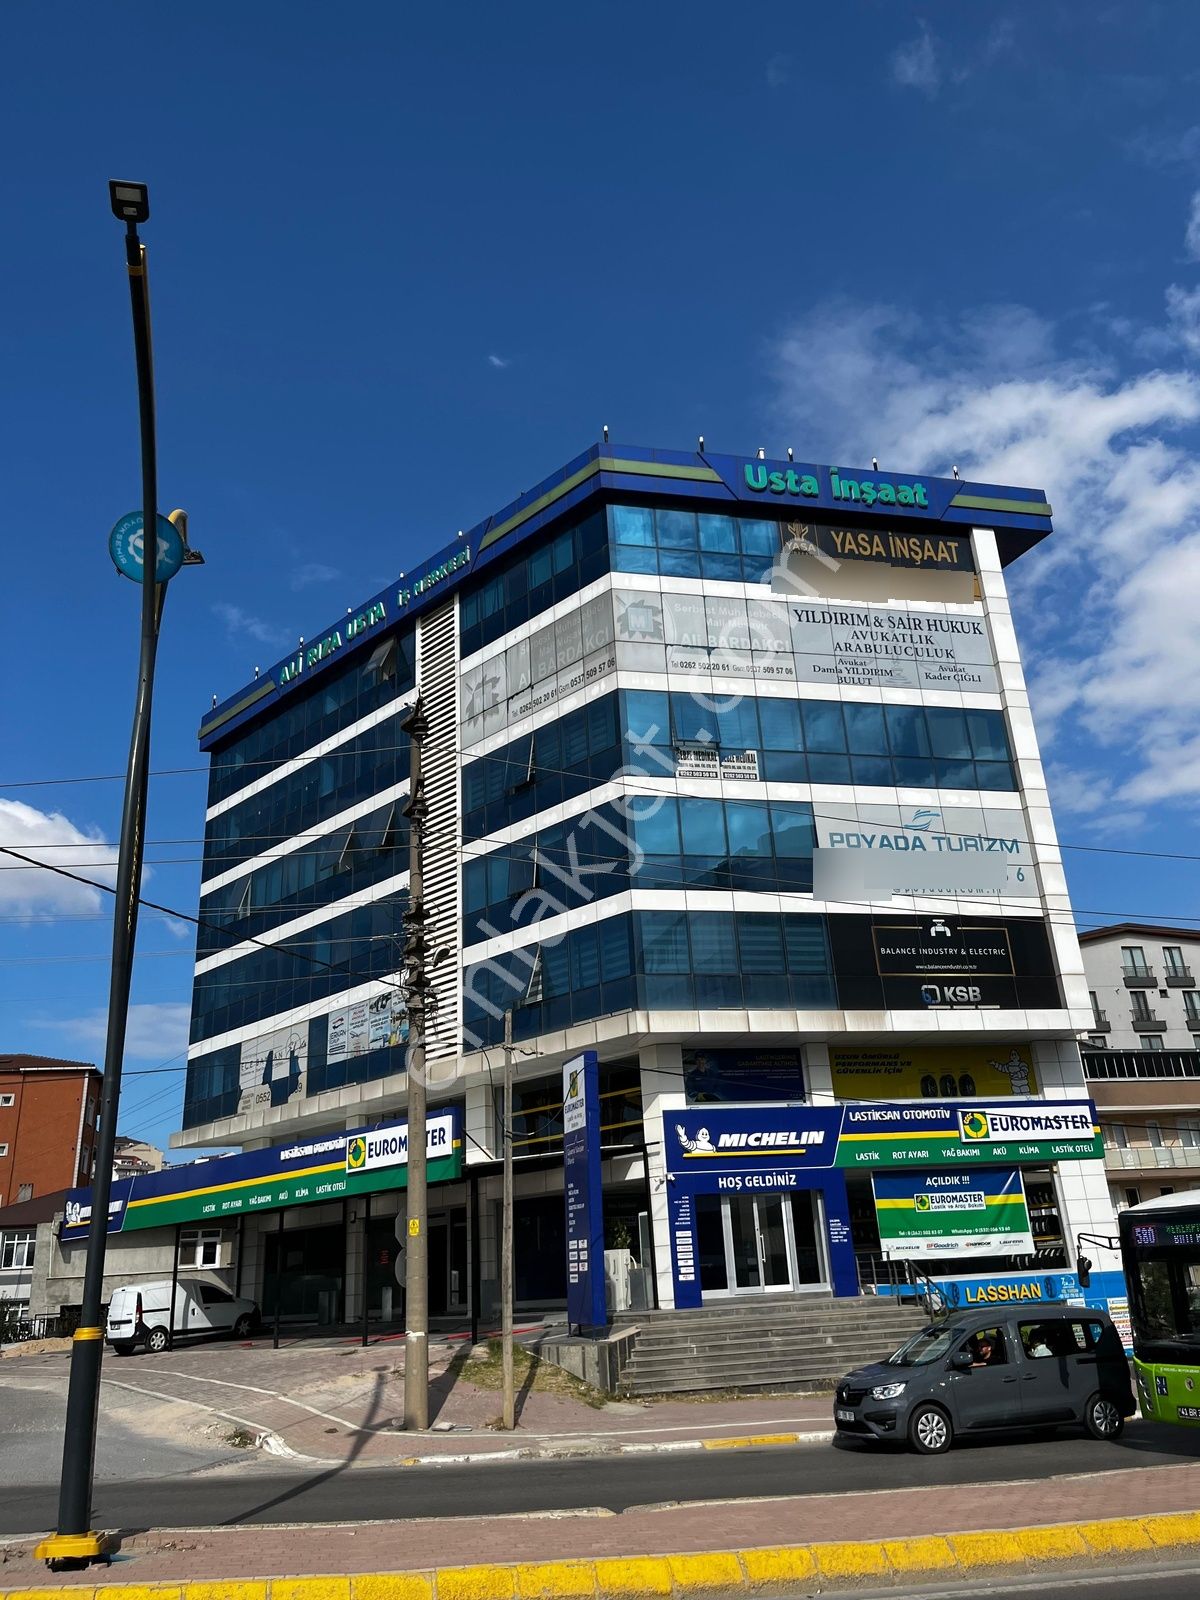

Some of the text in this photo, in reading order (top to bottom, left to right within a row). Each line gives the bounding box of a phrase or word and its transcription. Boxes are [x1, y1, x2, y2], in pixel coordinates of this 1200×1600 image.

[744, 464, 928, 508] Usta İnşaat
[785, 542, 816, 552] YASA
[830, 530, 959, 564] YASA İNŞAAT
[280, 652, 303, 684] ALİ
[307, 632, 342, 667] RIZA
[346, 602, 386, 640] USTA
[414, 545, 470, 596] MERKEZİ
[793, 609, 984, 635] YILDIRIM & SAİR HUKUK
[851, 631, 934, 645] AVUKATLIK
[834, 642, 955, 659] ARABULUCULUK
[838, 658, 866, 666] Avukat
[938, 665, 965, 673] Avukat
[586, 667, 597, 679] 509
[599, 662, 606, 672] 57
[846, 667, 893, 677] YILDIRIM
[925, 673, 951, 681] Kader
[837, 676, 872, 685] BULUT
[829, 832, 1020, 854] POYADA TURİZM
[880, 947, 916, 955] BALANCE
[970, 948, 1006, 956] ELECTRIC
[944, 986, 982, 1002] KSB
[849, 1106, 950, 1121] LASTİKSAN OTOMOTİV
[990, 1114, 1091, 1132] EUROMASTER
[368, 1127, 446, 1158] EUROMTER
[718, 1130, 824, 1148] MICHELIN
[856, 1142, 1093, 1161] LASTİK ROT AYARI YAĞ BAKIMI AKÜ KLİMA LASTİK OTELİ
[316, 1182, 332, 1194] LASTİK
[333, 1180, 346, 1192] OTELİ
[718, 1171, 797, 1190] HOŞ GELDİNİZ
[926, 1176, 970, 1188] AÇILDIK !!!
[930, 1194, 983, 1204] EUROMASTER
[965, 1283, 1042, 1303] LASSHAN
[1181, 1408, 1198, 1416] 41 BR
